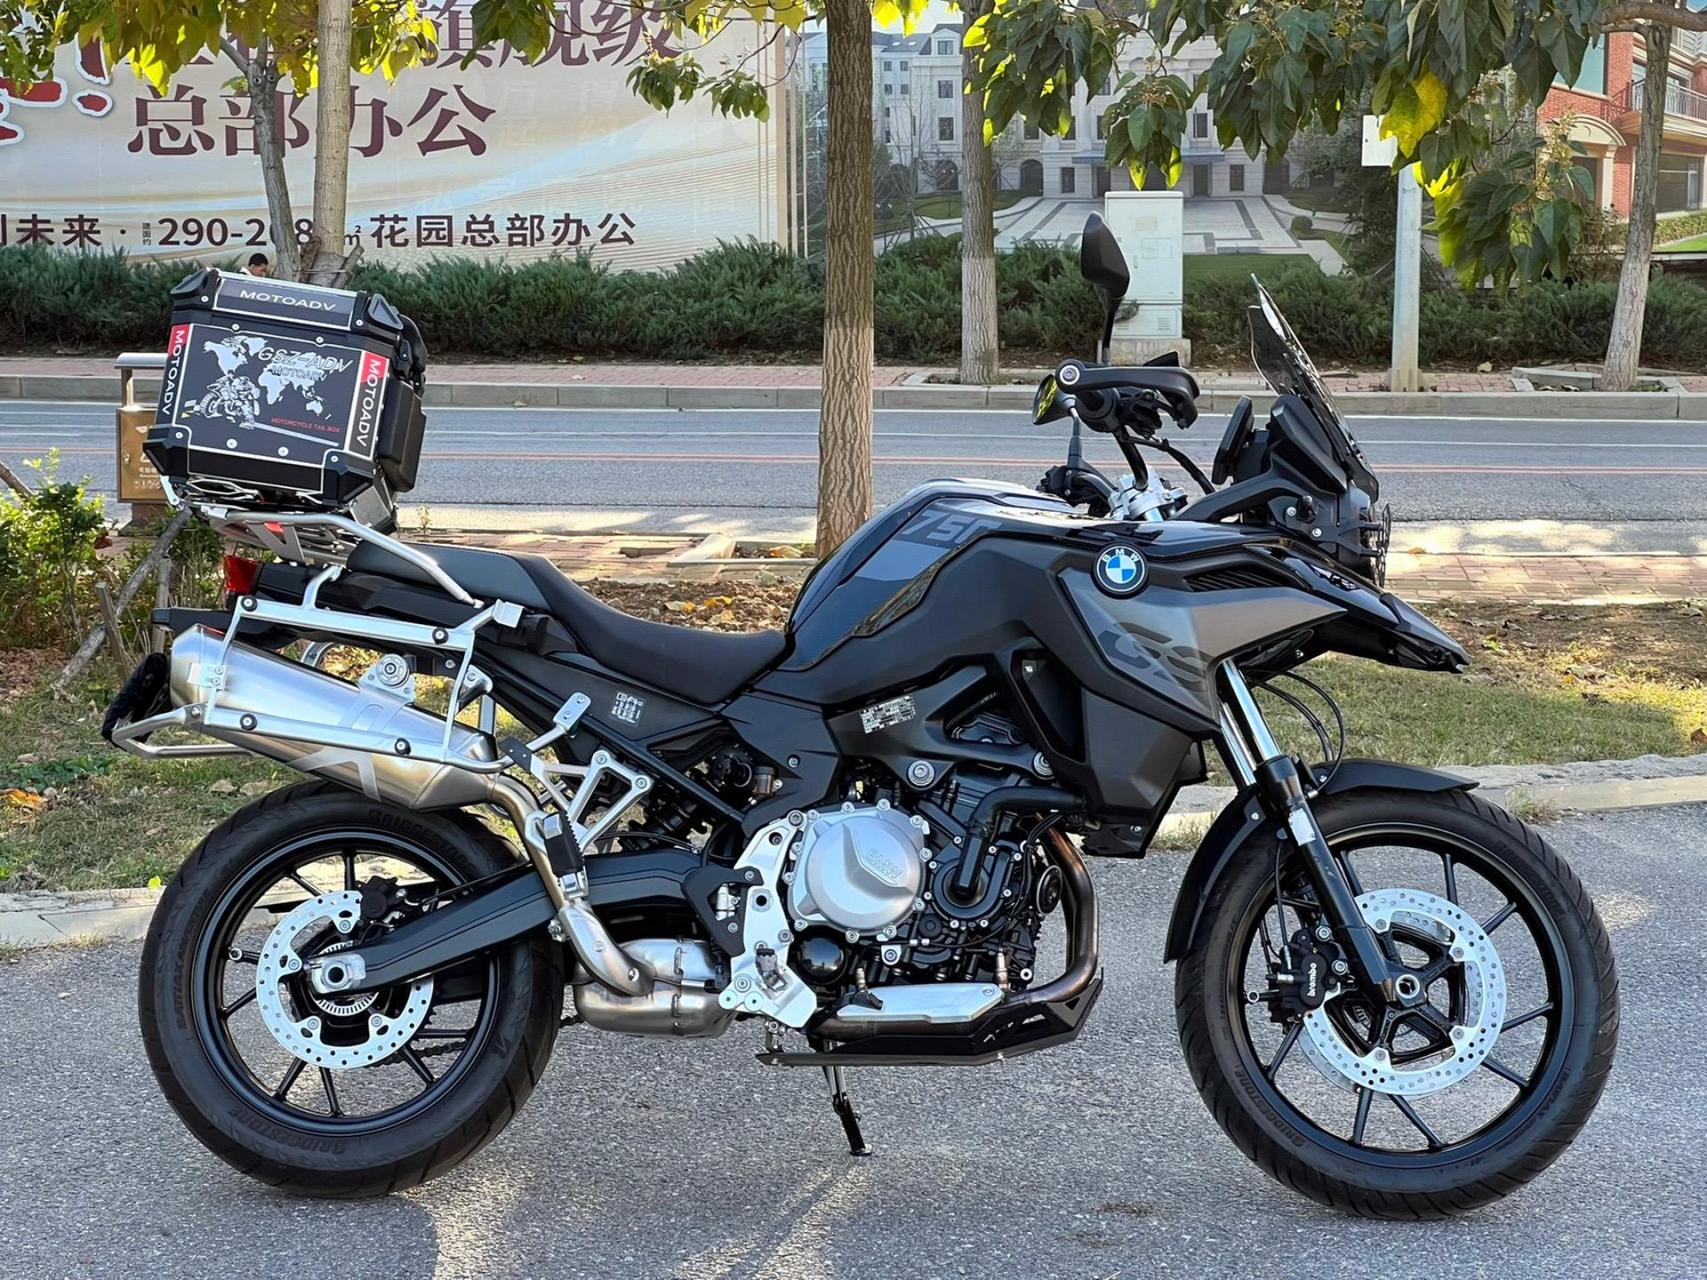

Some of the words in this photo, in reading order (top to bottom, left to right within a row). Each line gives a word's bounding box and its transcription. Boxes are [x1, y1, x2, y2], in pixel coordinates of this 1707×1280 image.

[128, 84, 497, 158] 总部办公
[0, 213, 102, 247] 未来
[158, 217, 315, 247] 290-28
[370, 213, 636, 248] 花园总部办公
[239, 289, 337, 312] MOTOADV
[162, 329, 186, 416] MOTOADV
[356, 359, 383, 448] MOTOADV
[1101, 548, 1141, 563] BMW
[1306, 962, 1317, 997] brembo
